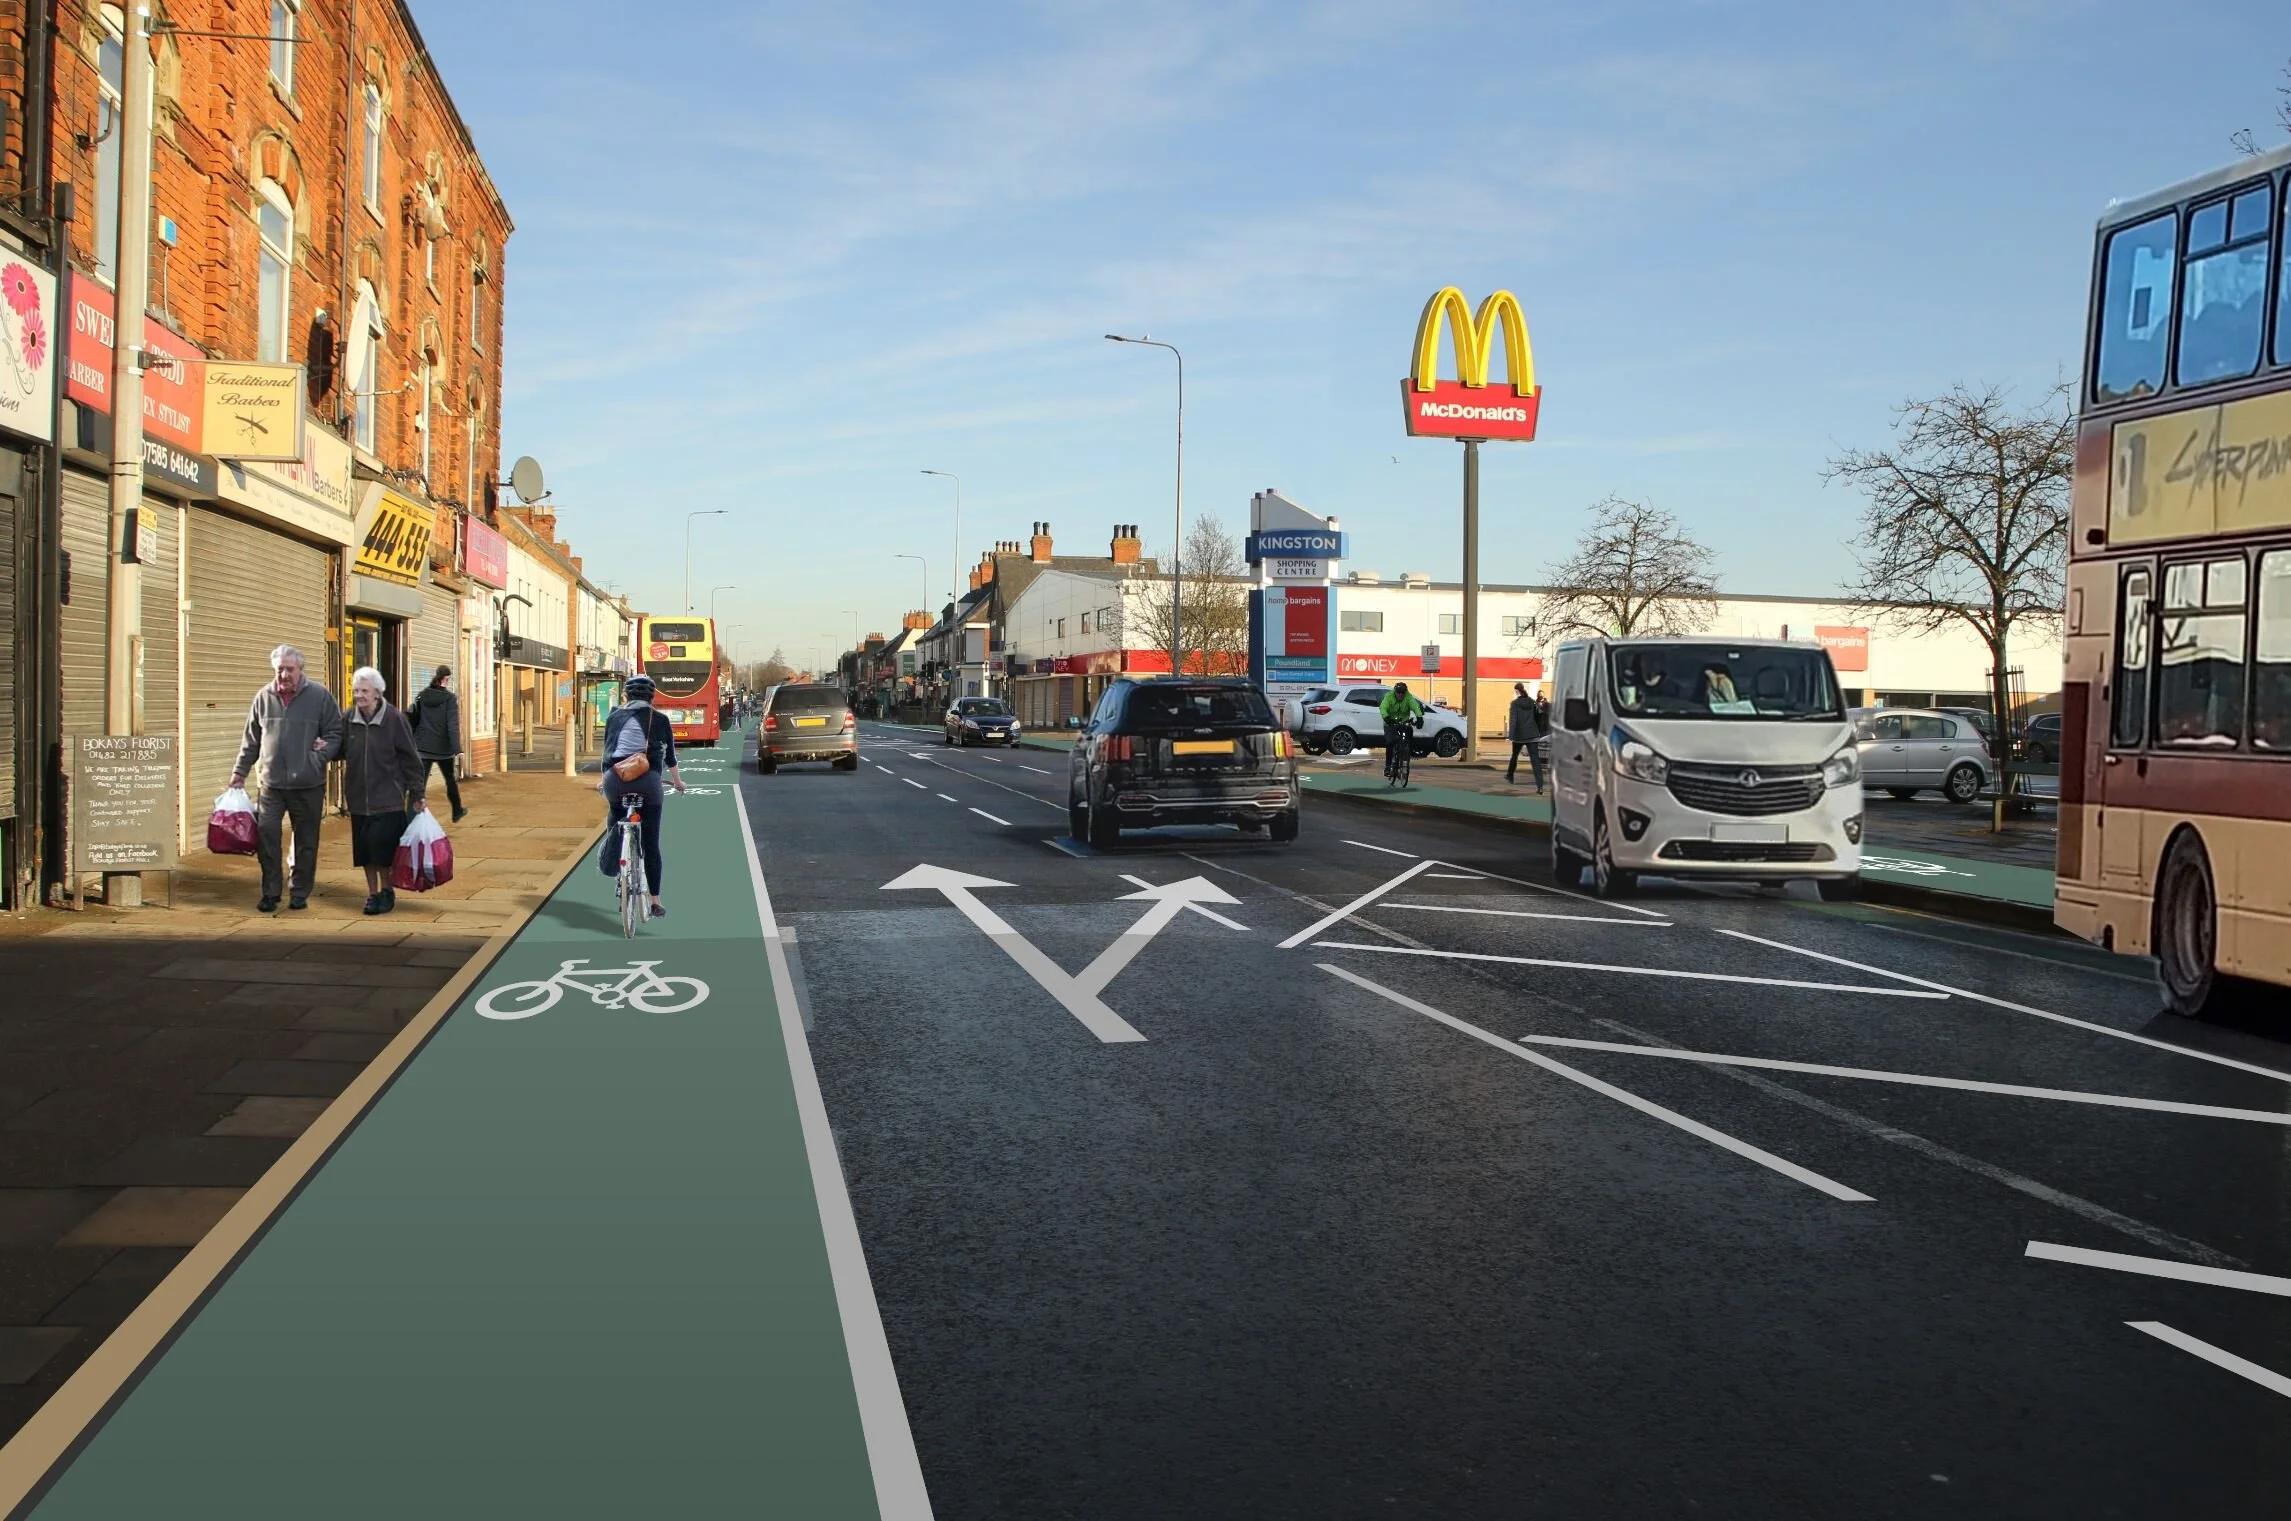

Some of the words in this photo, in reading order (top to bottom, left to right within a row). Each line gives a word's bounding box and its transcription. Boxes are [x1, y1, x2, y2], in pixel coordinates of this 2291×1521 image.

[206, 372, 296, 388] Traditional
[217, 393, 280, 407] Barbers
[158, 403, 191, 434] STYLIST
[1420, 402, 1527, 422] McDonald's
[170, 450, 199, 484] 641642
[314, 472, 343, 504] Barbers
[1258, 537, 1336, 550] KINGSTON
[1277, 560, 1317, 568] SHOPPING
[1277, 568, 1317, 576] CENTRE
[1289, 597, 1321, 606] bargains
[1821, 635, 1865, 649] bargains
[1274, 659, 1311, 667] Poundland
[1341, 658, 1398, 672] MONEY
[83, 738, 127, 752] BOKAYS
[132, 737, 172, 750] FLORIST
[89, 751, 116, 760] 01482
[120, 749, 158, 760] 217885
[128, 848, 158, 858] Facebook
